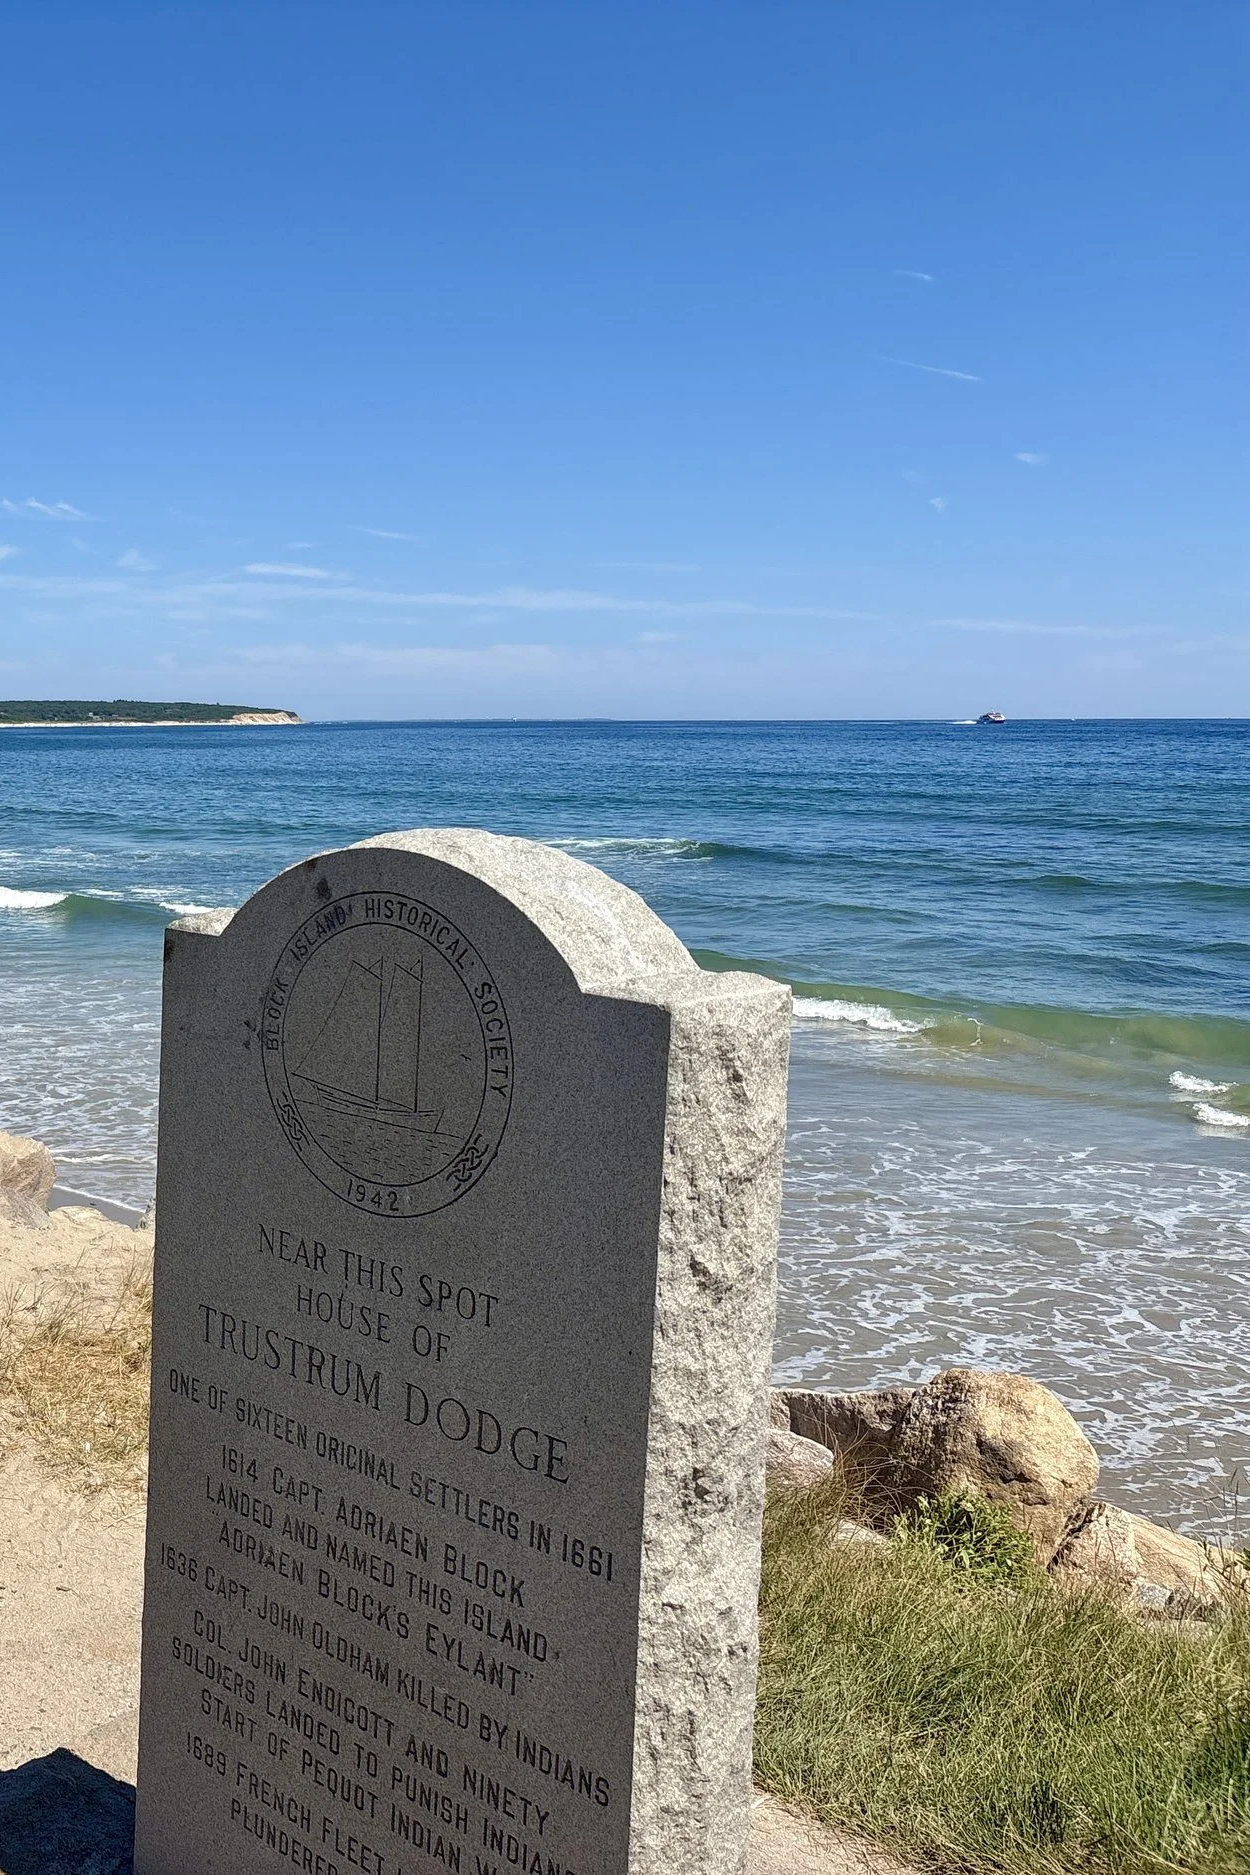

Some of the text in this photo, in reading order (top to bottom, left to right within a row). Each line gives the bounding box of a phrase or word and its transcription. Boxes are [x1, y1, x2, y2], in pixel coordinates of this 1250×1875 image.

[266, 898, 508, 1098] BLOCK ISLAND HISTORICAL SOCIETY
[258, 1223, 499, 1328] NEAR THIS SPOT
[347, 1178, 400, 1212] 1942
[198, 1303, 570, 1485] TRUSTRUM DODGE
[297, 1284, 451, 1362] HOUSE OF
[169, 1368, 200, 1403] ONE
[208, 1385, 228, 1413] OF
[236, 1397, 307, 1451] SIXTEEN
[410, 1470, 519, 1541] SETTLERS
[530, 1520, 551, 1554] IN
[562, 1533, 613, 1582] 1661
[206, 1475, 273, 1530] LANDED
[282, 1513, 319, 1551] AND
[326, 1532, 395, 1589] NAMED
[406, 1570, 452, 1616] THIS
[222, 1444, 525, 1609] 1614 CAPT. ADRIAEN BLOCK
[161, 1542, 611, 1808] 1636 CAPT. JOHN OLDHAM KILLED BY INDIANS
[172, 1635, 576, 1875] SOLDIERS LANDED TO PUNISH INDIAN
[194, 1609, 550, 1836] COL. JOHN ENDICOTT AND NINETY
[186, 1731, 385, 1875] 1689 FRENCH FLEET
[201, 1688, 461, 1874] START OF PEQUOT INDIAN
